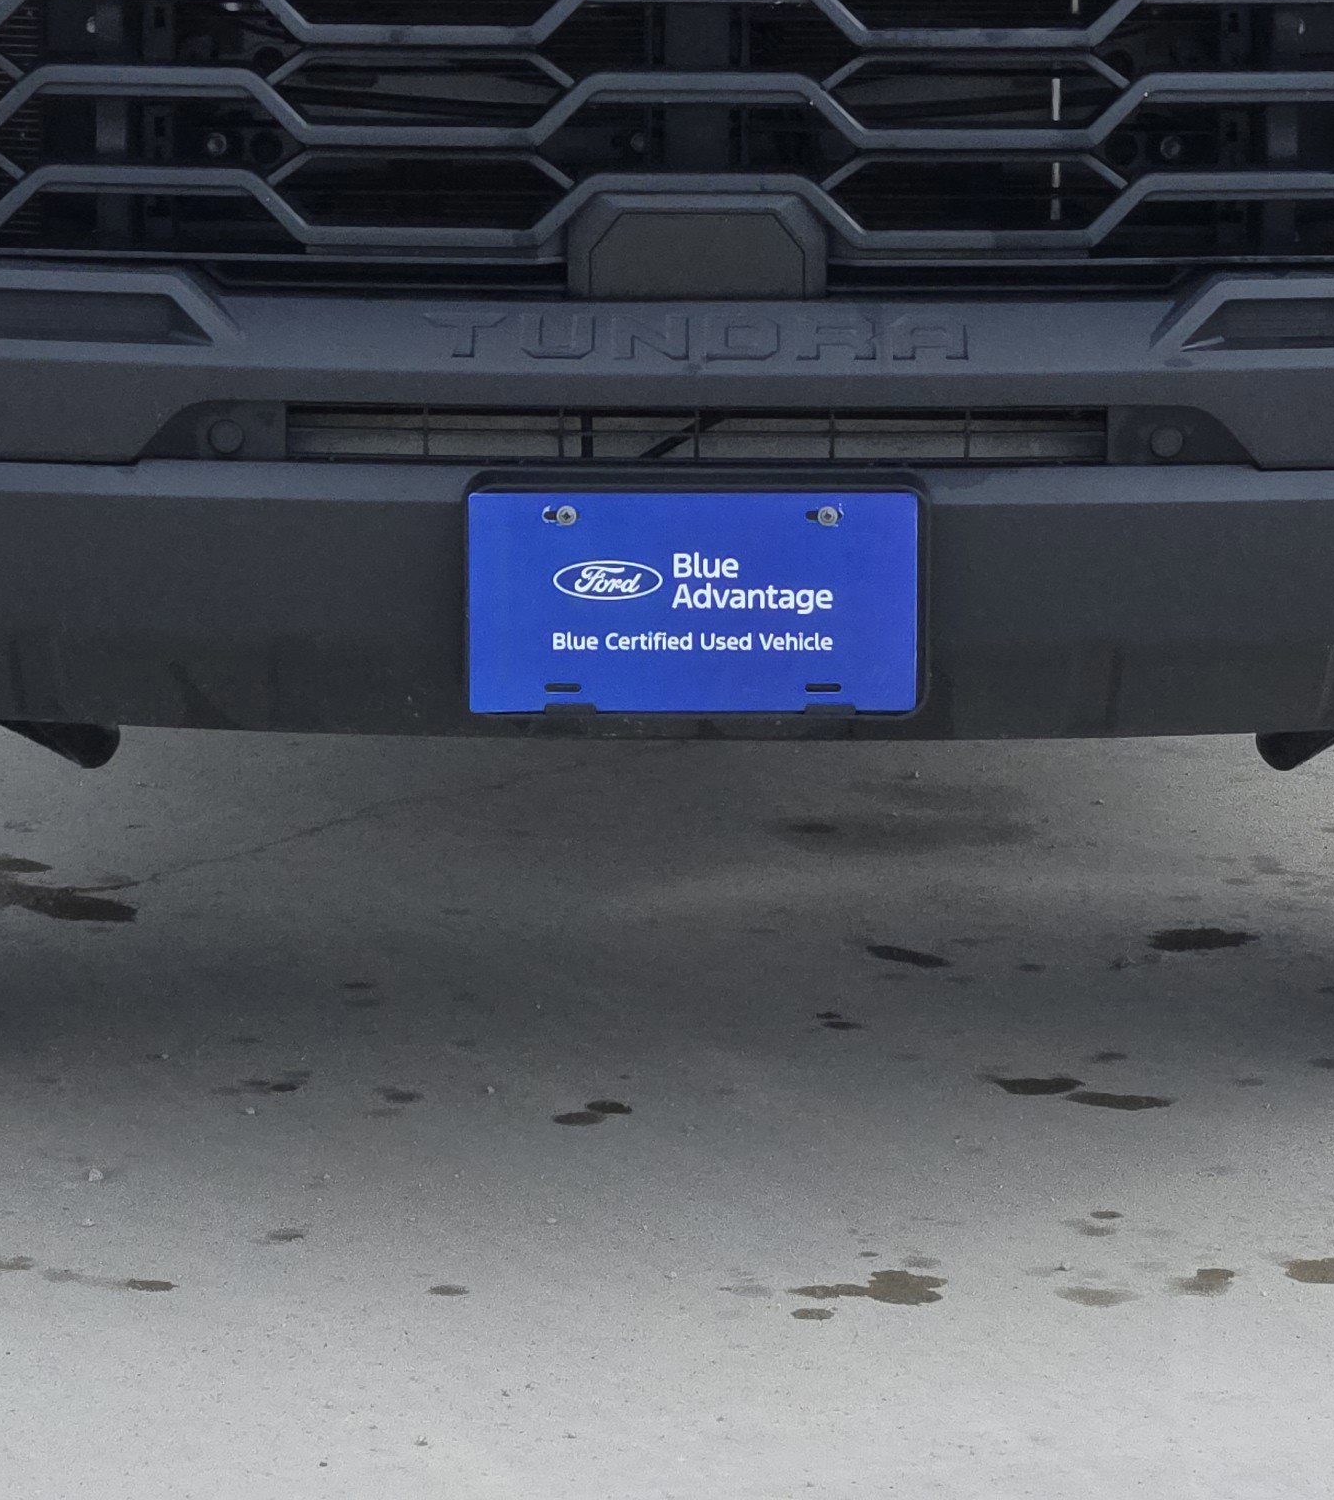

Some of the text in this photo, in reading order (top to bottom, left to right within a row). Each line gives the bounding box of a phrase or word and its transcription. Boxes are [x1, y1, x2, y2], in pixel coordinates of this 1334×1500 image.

[423, 313, 969, 360] TUNDRA
[673, 552, 739, 578] Blue
[574, 566, 642, 593] Ford
[672, 582, 833, 614] Advantage
[552, 631, 833, 650] Blue Certified Used Vehicle
